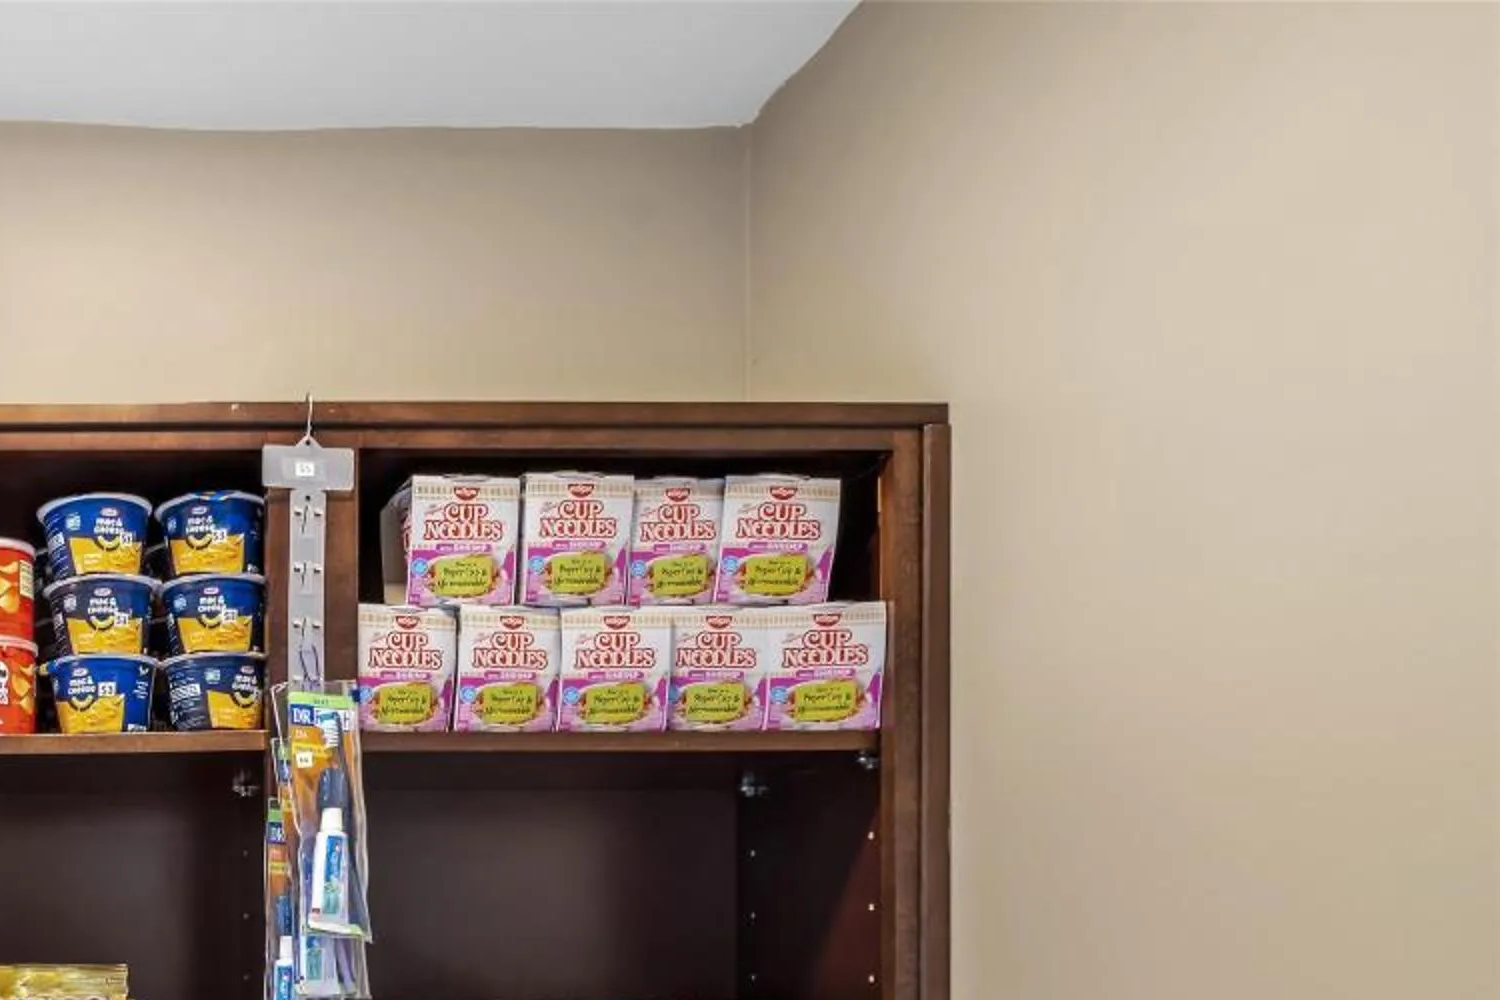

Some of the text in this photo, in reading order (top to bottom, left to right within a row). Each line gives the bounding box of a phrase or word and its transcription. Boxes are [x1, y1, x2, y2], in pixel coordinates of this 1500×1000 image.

[444, 503, 488, 521] CUP
[558, 500, 604, 519] CUP
[659, 504, 699, 522] CUP
[759, 503, 804, 521] CUP
[424, 521, 502, 540] NOODLES
[540, 518, 616, 537] NOODLES
[640, 522, 716, 541] NOODLES
[737, 520, 820, 539] NOODLES
[387, 632, 428, 650] CUP
[492, 632, 533, 650] CUP
[596, 632, 640, 650] CUP
[697, 631, 741, 649] CUP
[803, 630, 852, 648] CUP
[368, 650, 442, 668] NOODLES
[472, 650, 548, 669] NOODLES
[575, 650, 655, 668] NOODLES
[676, 650, 756, 668] NOODLES
[782, 647, 868, 668] NOODLES
